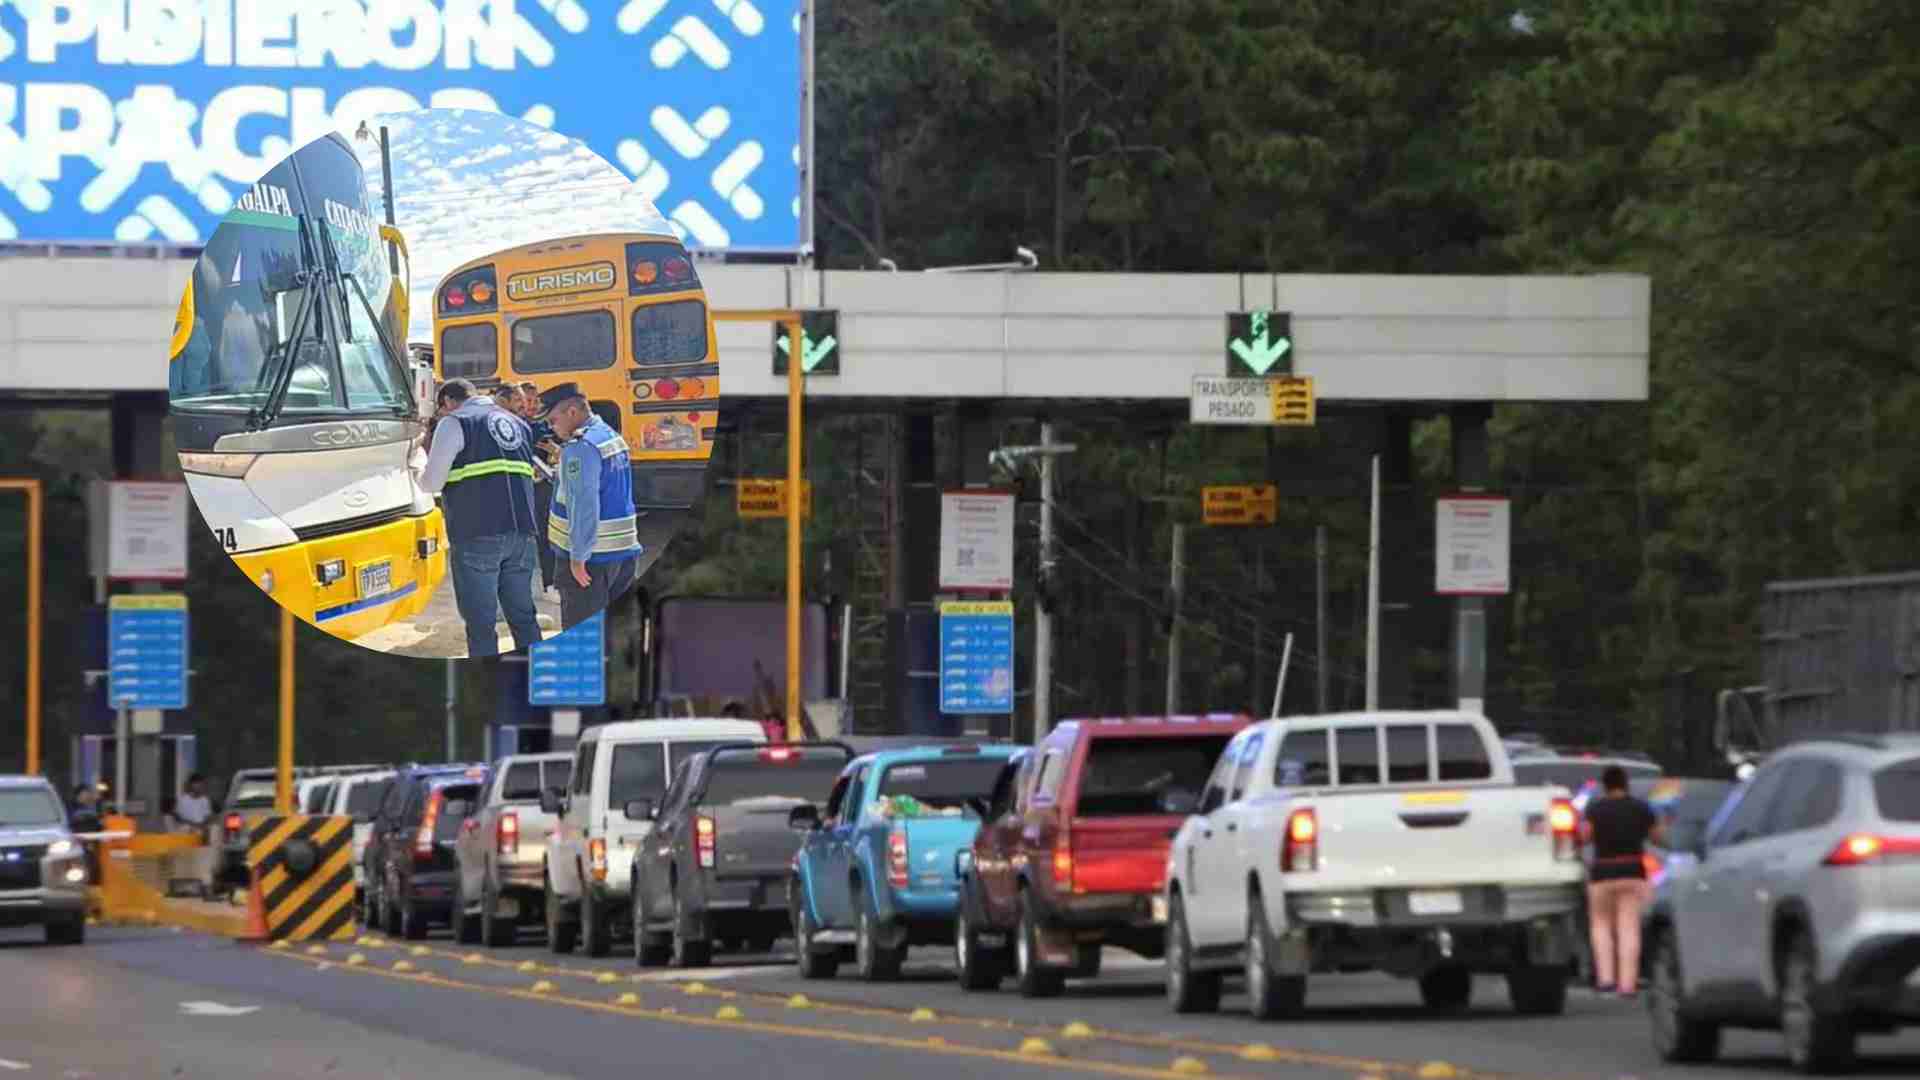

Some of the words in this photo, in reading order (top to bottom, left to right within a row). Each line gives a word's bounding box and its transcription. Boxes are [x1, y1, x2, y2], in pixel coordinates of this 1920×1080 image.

[508, 267, 614, 293] TURISMO
[1197, 380, 1271, 398] TRANSPORTE
[1209, 401, 1256, 417] PESADO
[310, 422, 392, 446] COMIL
